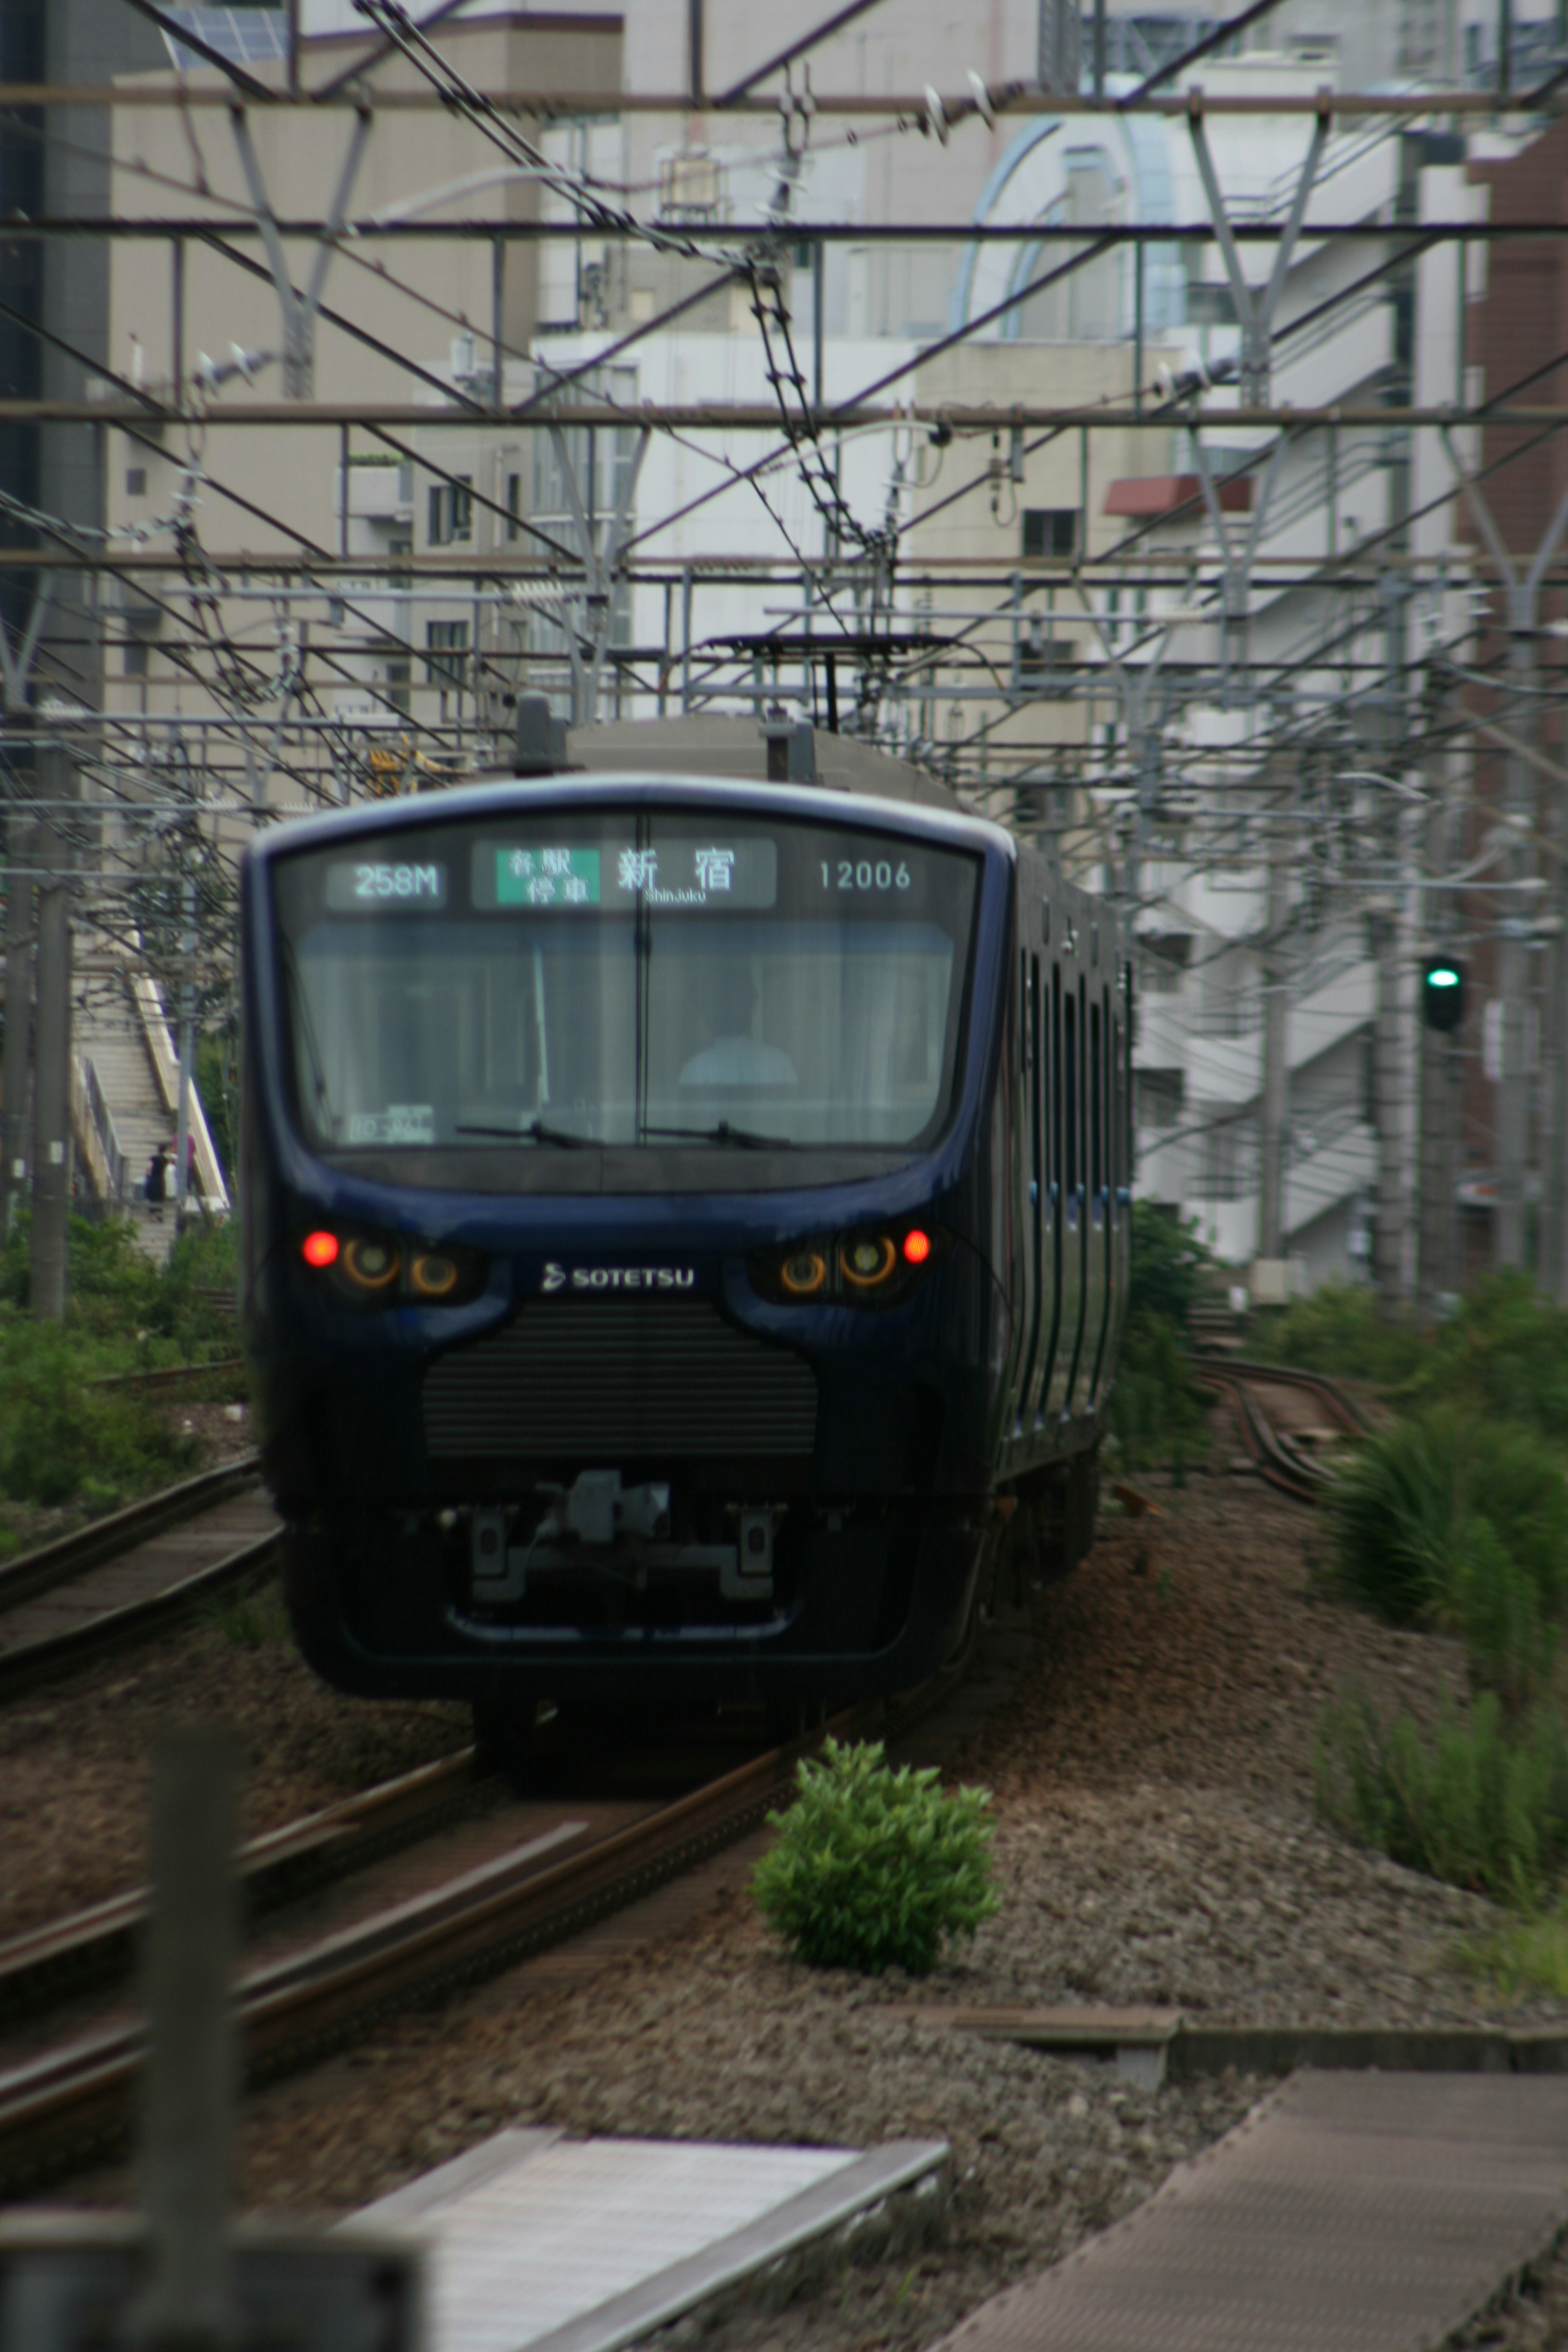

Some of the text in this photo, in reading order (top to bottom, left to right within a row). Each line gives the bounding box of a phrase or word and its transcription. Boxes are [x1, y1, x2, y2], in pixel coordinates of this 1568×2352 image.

[354, 864, 437, 896] 258M
[618, 845, 735, 891] 新宿
[820, 861, 911, 889] 12006
[572, 1268, 694, 1287] SOTETSU
